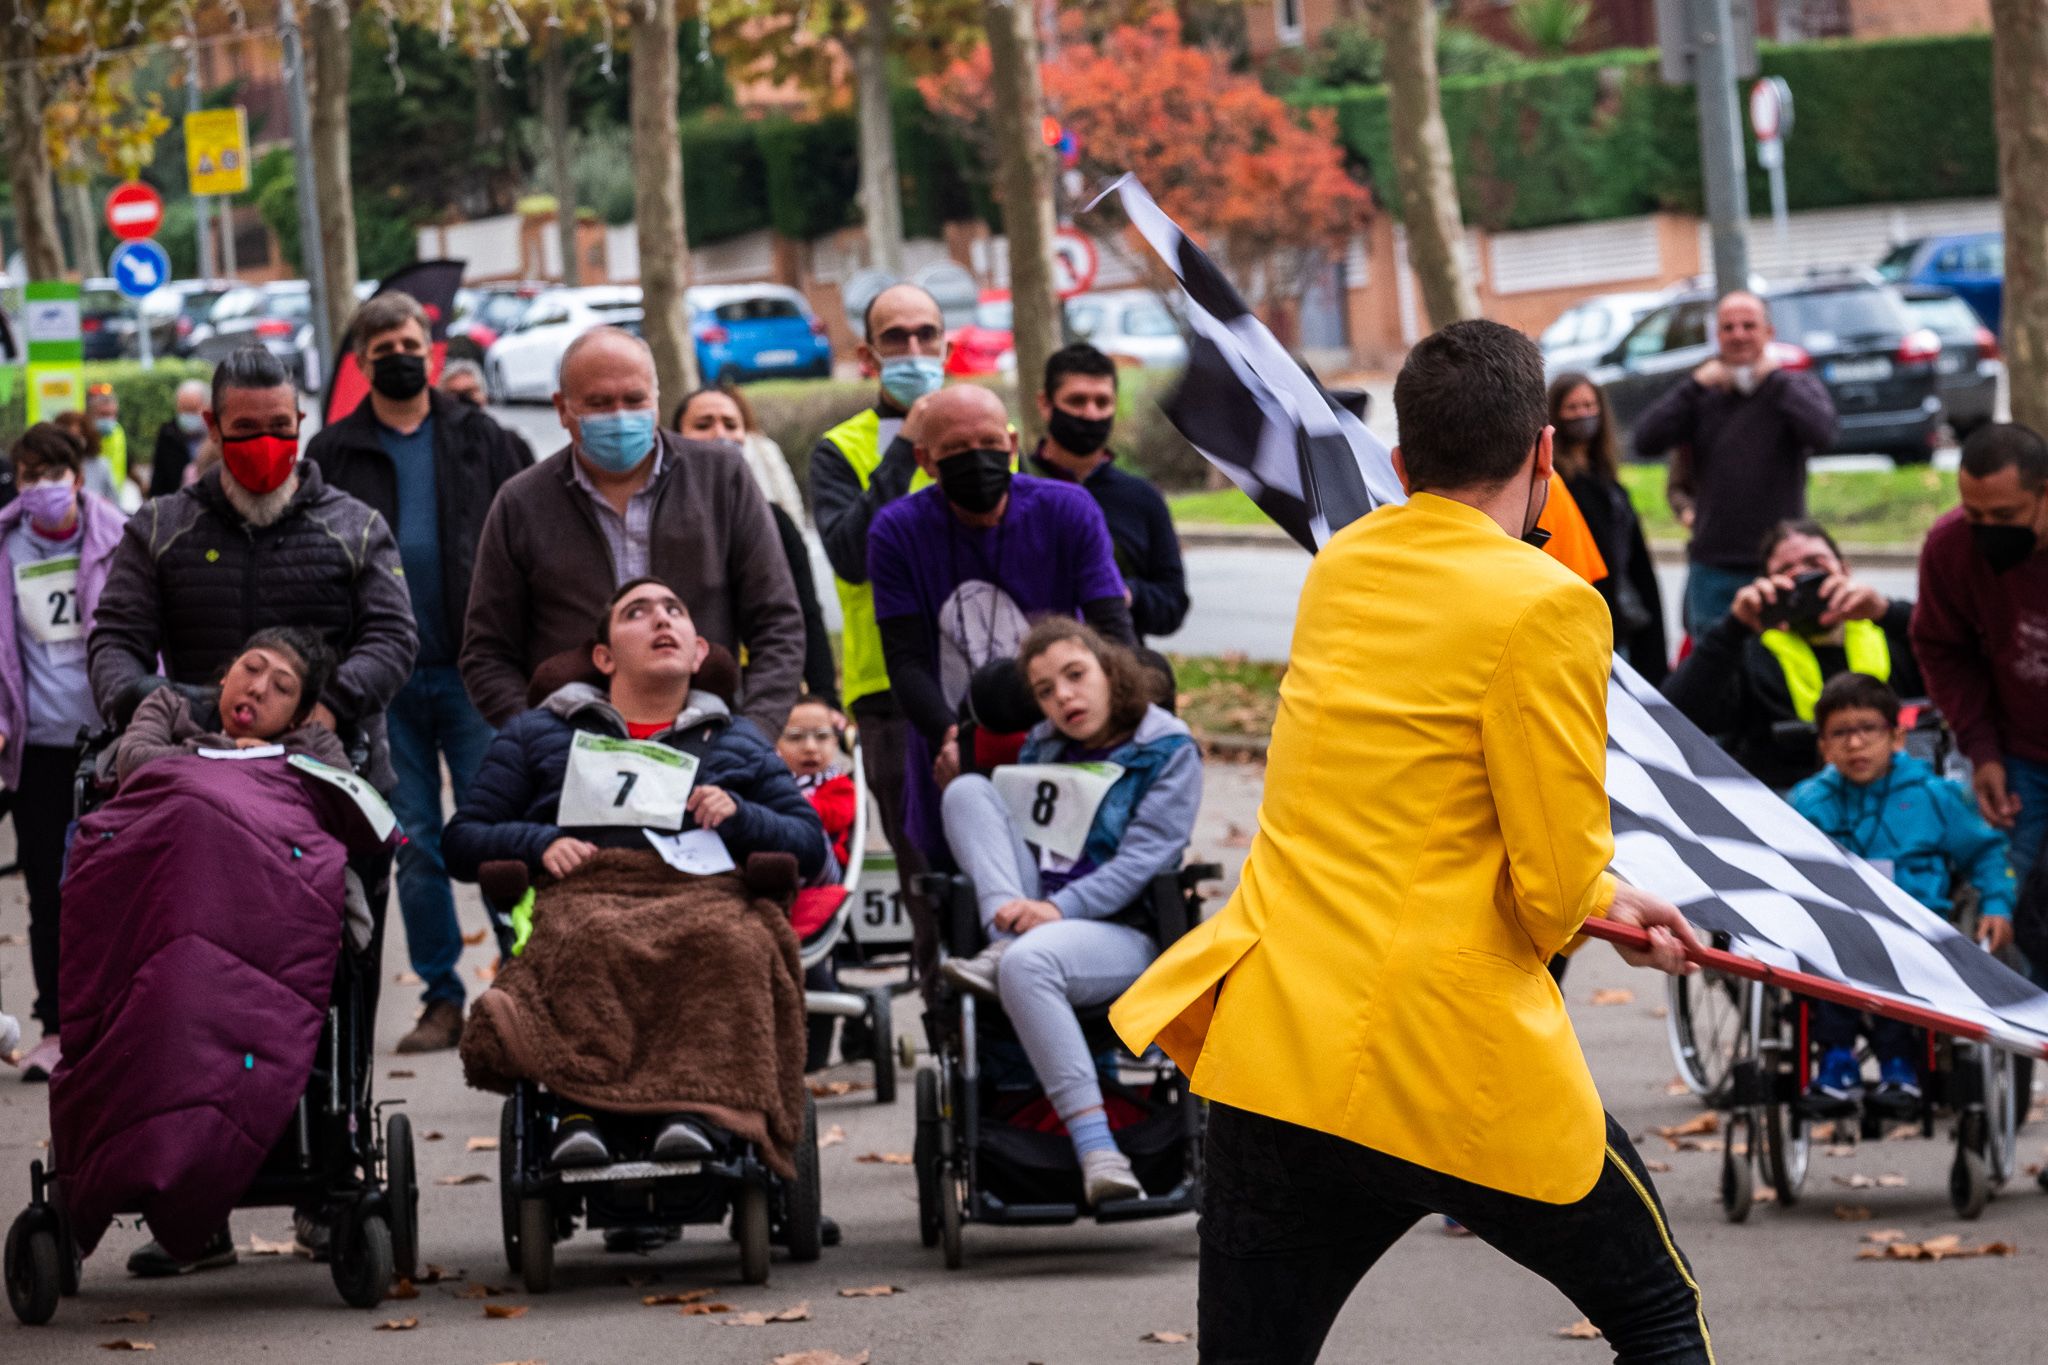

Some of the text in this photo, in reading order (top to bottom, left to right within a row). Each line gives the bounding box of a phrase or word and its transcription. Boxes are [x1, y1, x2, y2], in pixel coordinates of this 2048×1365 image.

[613, 771, 638, 807] 7
[1032, 780, 1058, 827] 8
[864, 890, 902, 926] 51
